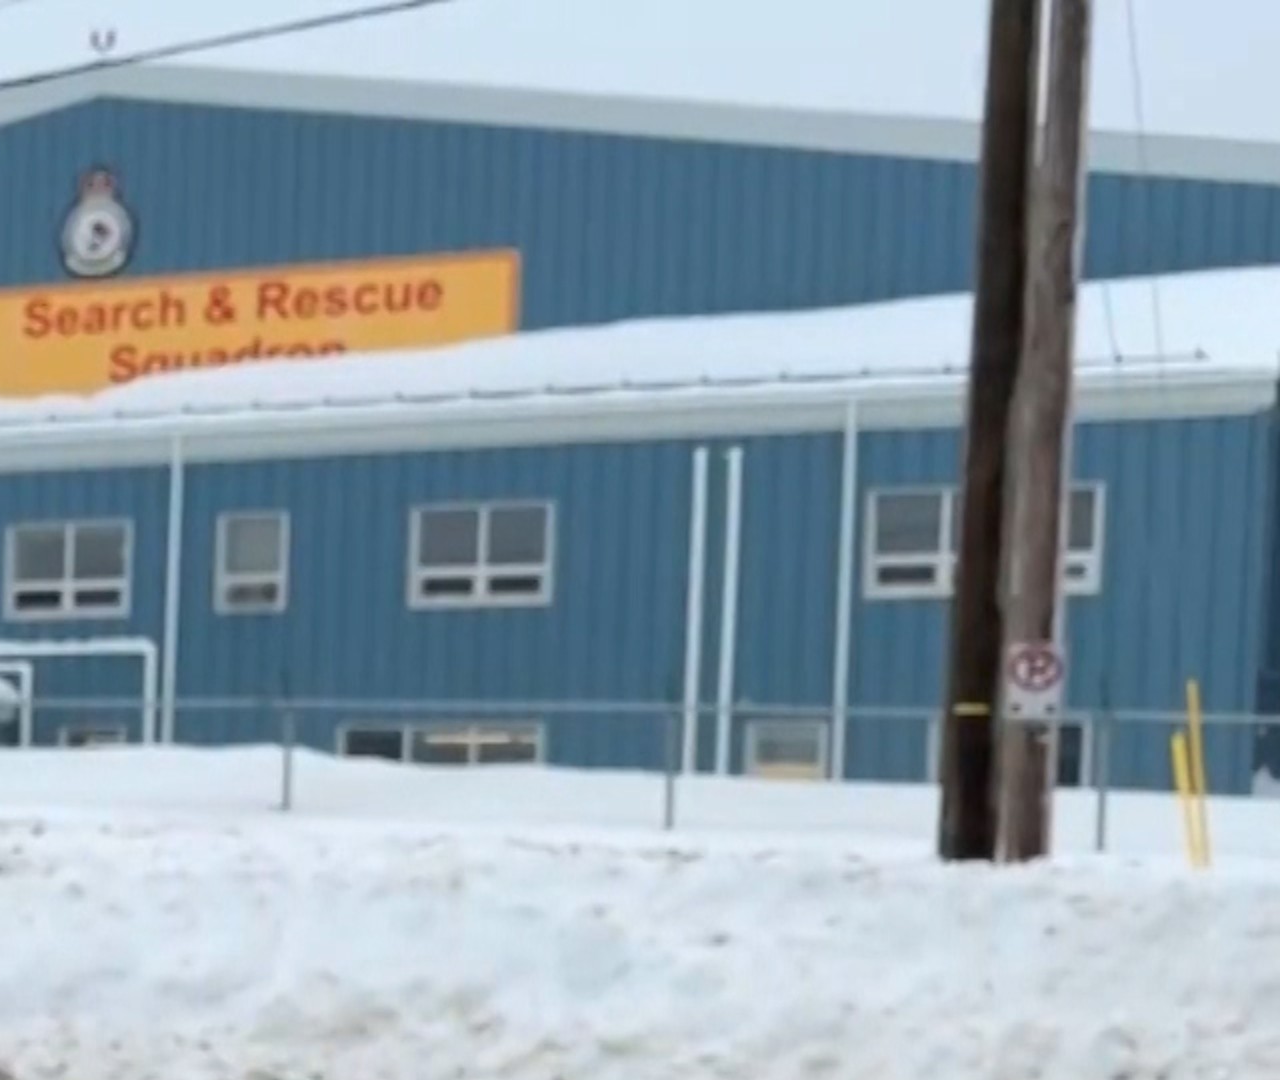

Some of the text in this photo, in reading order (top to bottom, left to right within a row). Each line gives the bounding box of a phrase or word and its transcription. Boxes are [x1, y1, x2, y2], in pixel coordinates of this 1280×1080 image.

[23, 280, 444, 338] Search & Rescue
